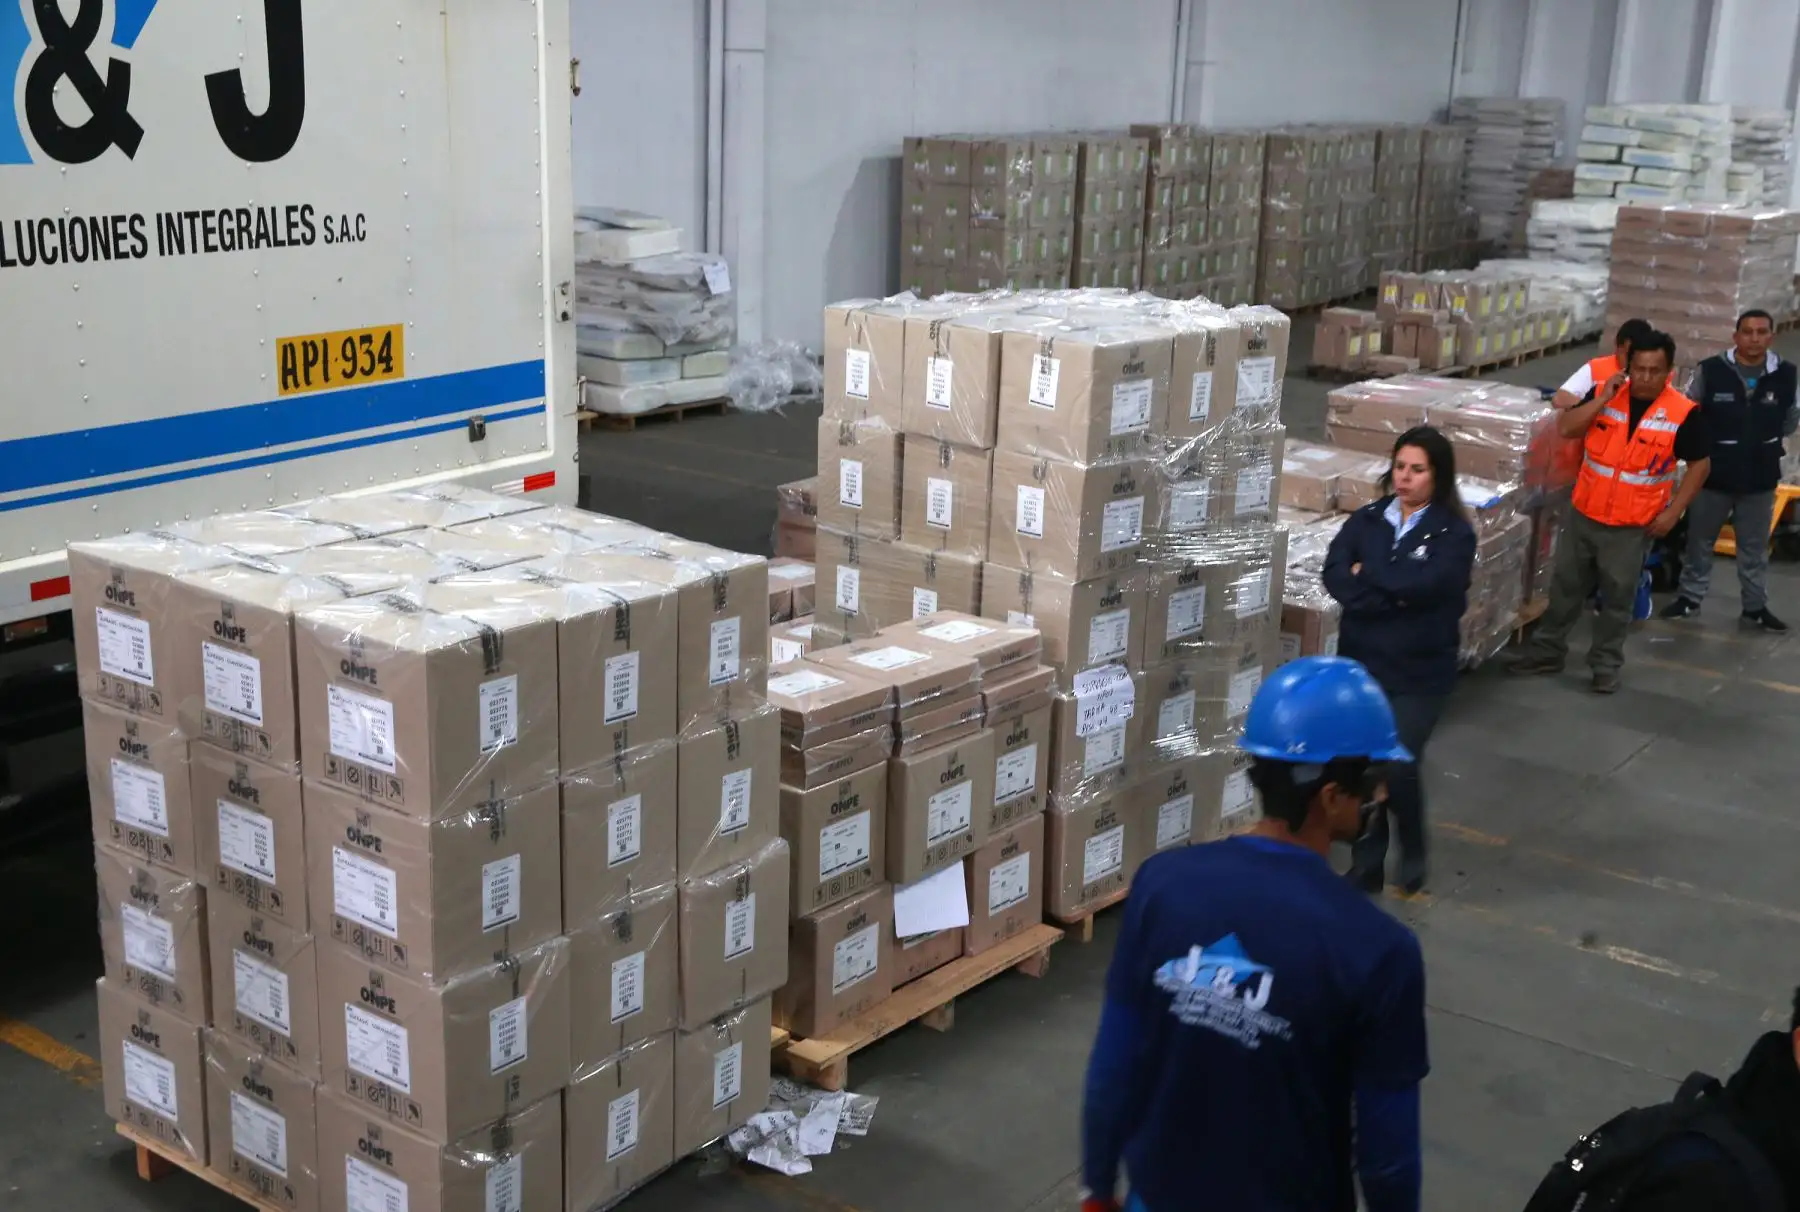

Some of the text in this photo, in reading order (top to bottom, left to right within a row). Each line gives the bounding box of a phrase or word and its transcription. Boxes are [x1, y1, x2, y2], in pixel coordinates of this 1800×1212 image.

[157, 203, 316, 257] INTEGRALES
[105, 580, 136, 607] ONPE
[213, 619, 247, 644] ONPE
[340, 659, 378, 686] ONPE
[118, 737, 149, 760] ONPE
[1006, 728, 1028, 747] ONPE
[940, 764, 965, 784] ONPE
[228, 779, 260, 804] ONPE
[830, 794, 860, 816] ONPE
[345, 826, 383, 853] ONPE
[242, 930, 275, 956] ONPE
[359, 985, 397, 1015] ONPE
[1243, 970, 1274, 1012] J
[131, 1023, 161, 1048] ONPE
[242, 1074, 274, 1101] ONPE
[358, 1137, 394, 1166] ONPE
